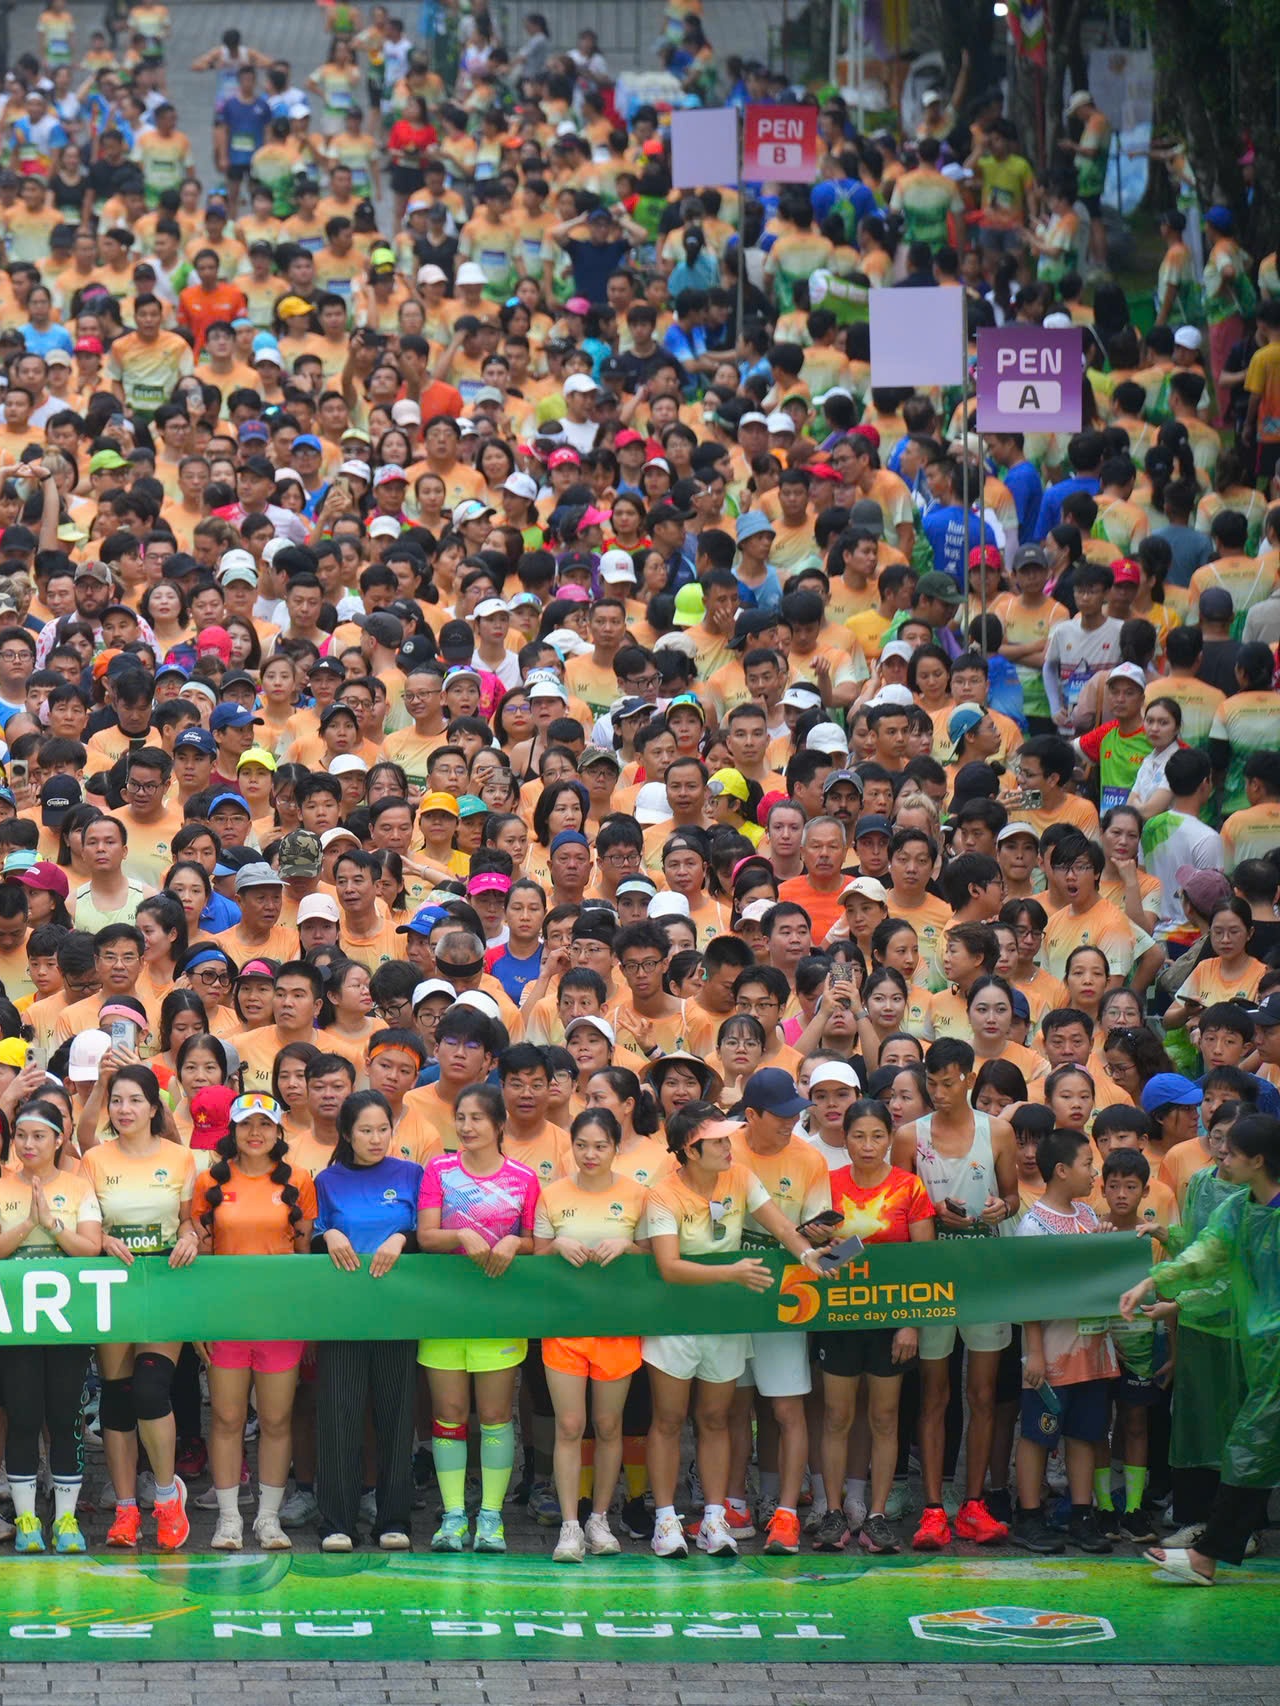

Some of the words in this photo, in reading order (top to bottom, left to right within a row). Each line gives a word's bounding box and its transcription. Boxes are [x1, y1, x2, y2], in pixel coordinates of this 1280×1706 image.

[757, 118, 804, 139] PEN
[773, 147, 786, 164] B
[997, 348, 1062, 375] PEN
[1018, 385, 1041, 409] A
[121, 1235, 158, 1249] 1004
[777, 1264, 821, 1325] 5
[827, 1282, 954, 1307] EDITION
[828, 1312, 860, 1322] Race
[864, 1310, 888, 1323] day
[891, 1306, 957, 1320] 09.11.2025
[213, 1621, 375, 1638] AN
[430, 1621, 847, 1639] TRANG
